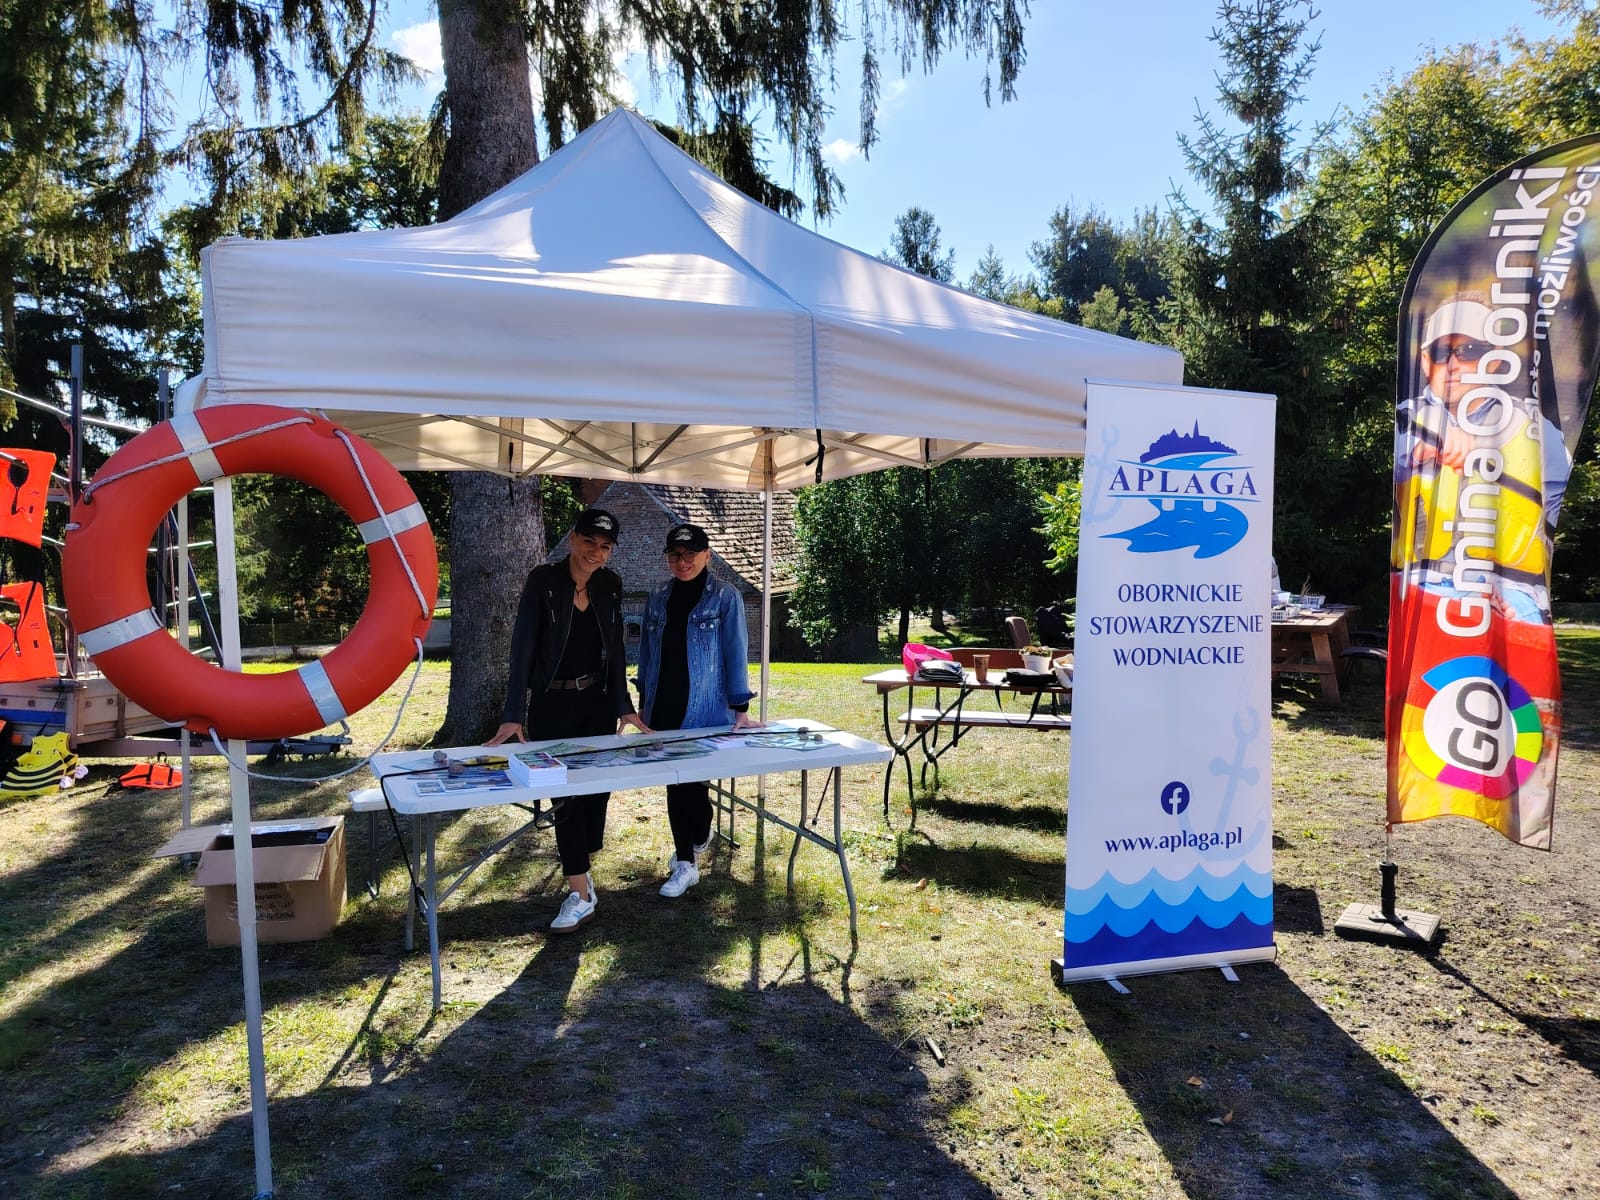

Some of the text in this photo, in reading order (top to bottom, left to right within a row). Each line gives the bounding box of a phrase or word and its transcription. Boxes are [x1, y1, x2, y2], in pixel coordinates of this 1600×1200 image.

[1532, 165, 1600, 340] możliwości
[1436, 166, 1568, 637] Gmina Oborniki
[1108, 465, 1257, 496] APLAGA
[1117, 583, 1243, 603] OBORNICKIE
[1089, 614, 1264, 636] STOWARZYSZENIE
[1112, 645, 1246, 667] WODNIACKIE
[1447, 680, 1503, 772] GO
[1103, 826, 1243, 853] www.aplaga.pl
